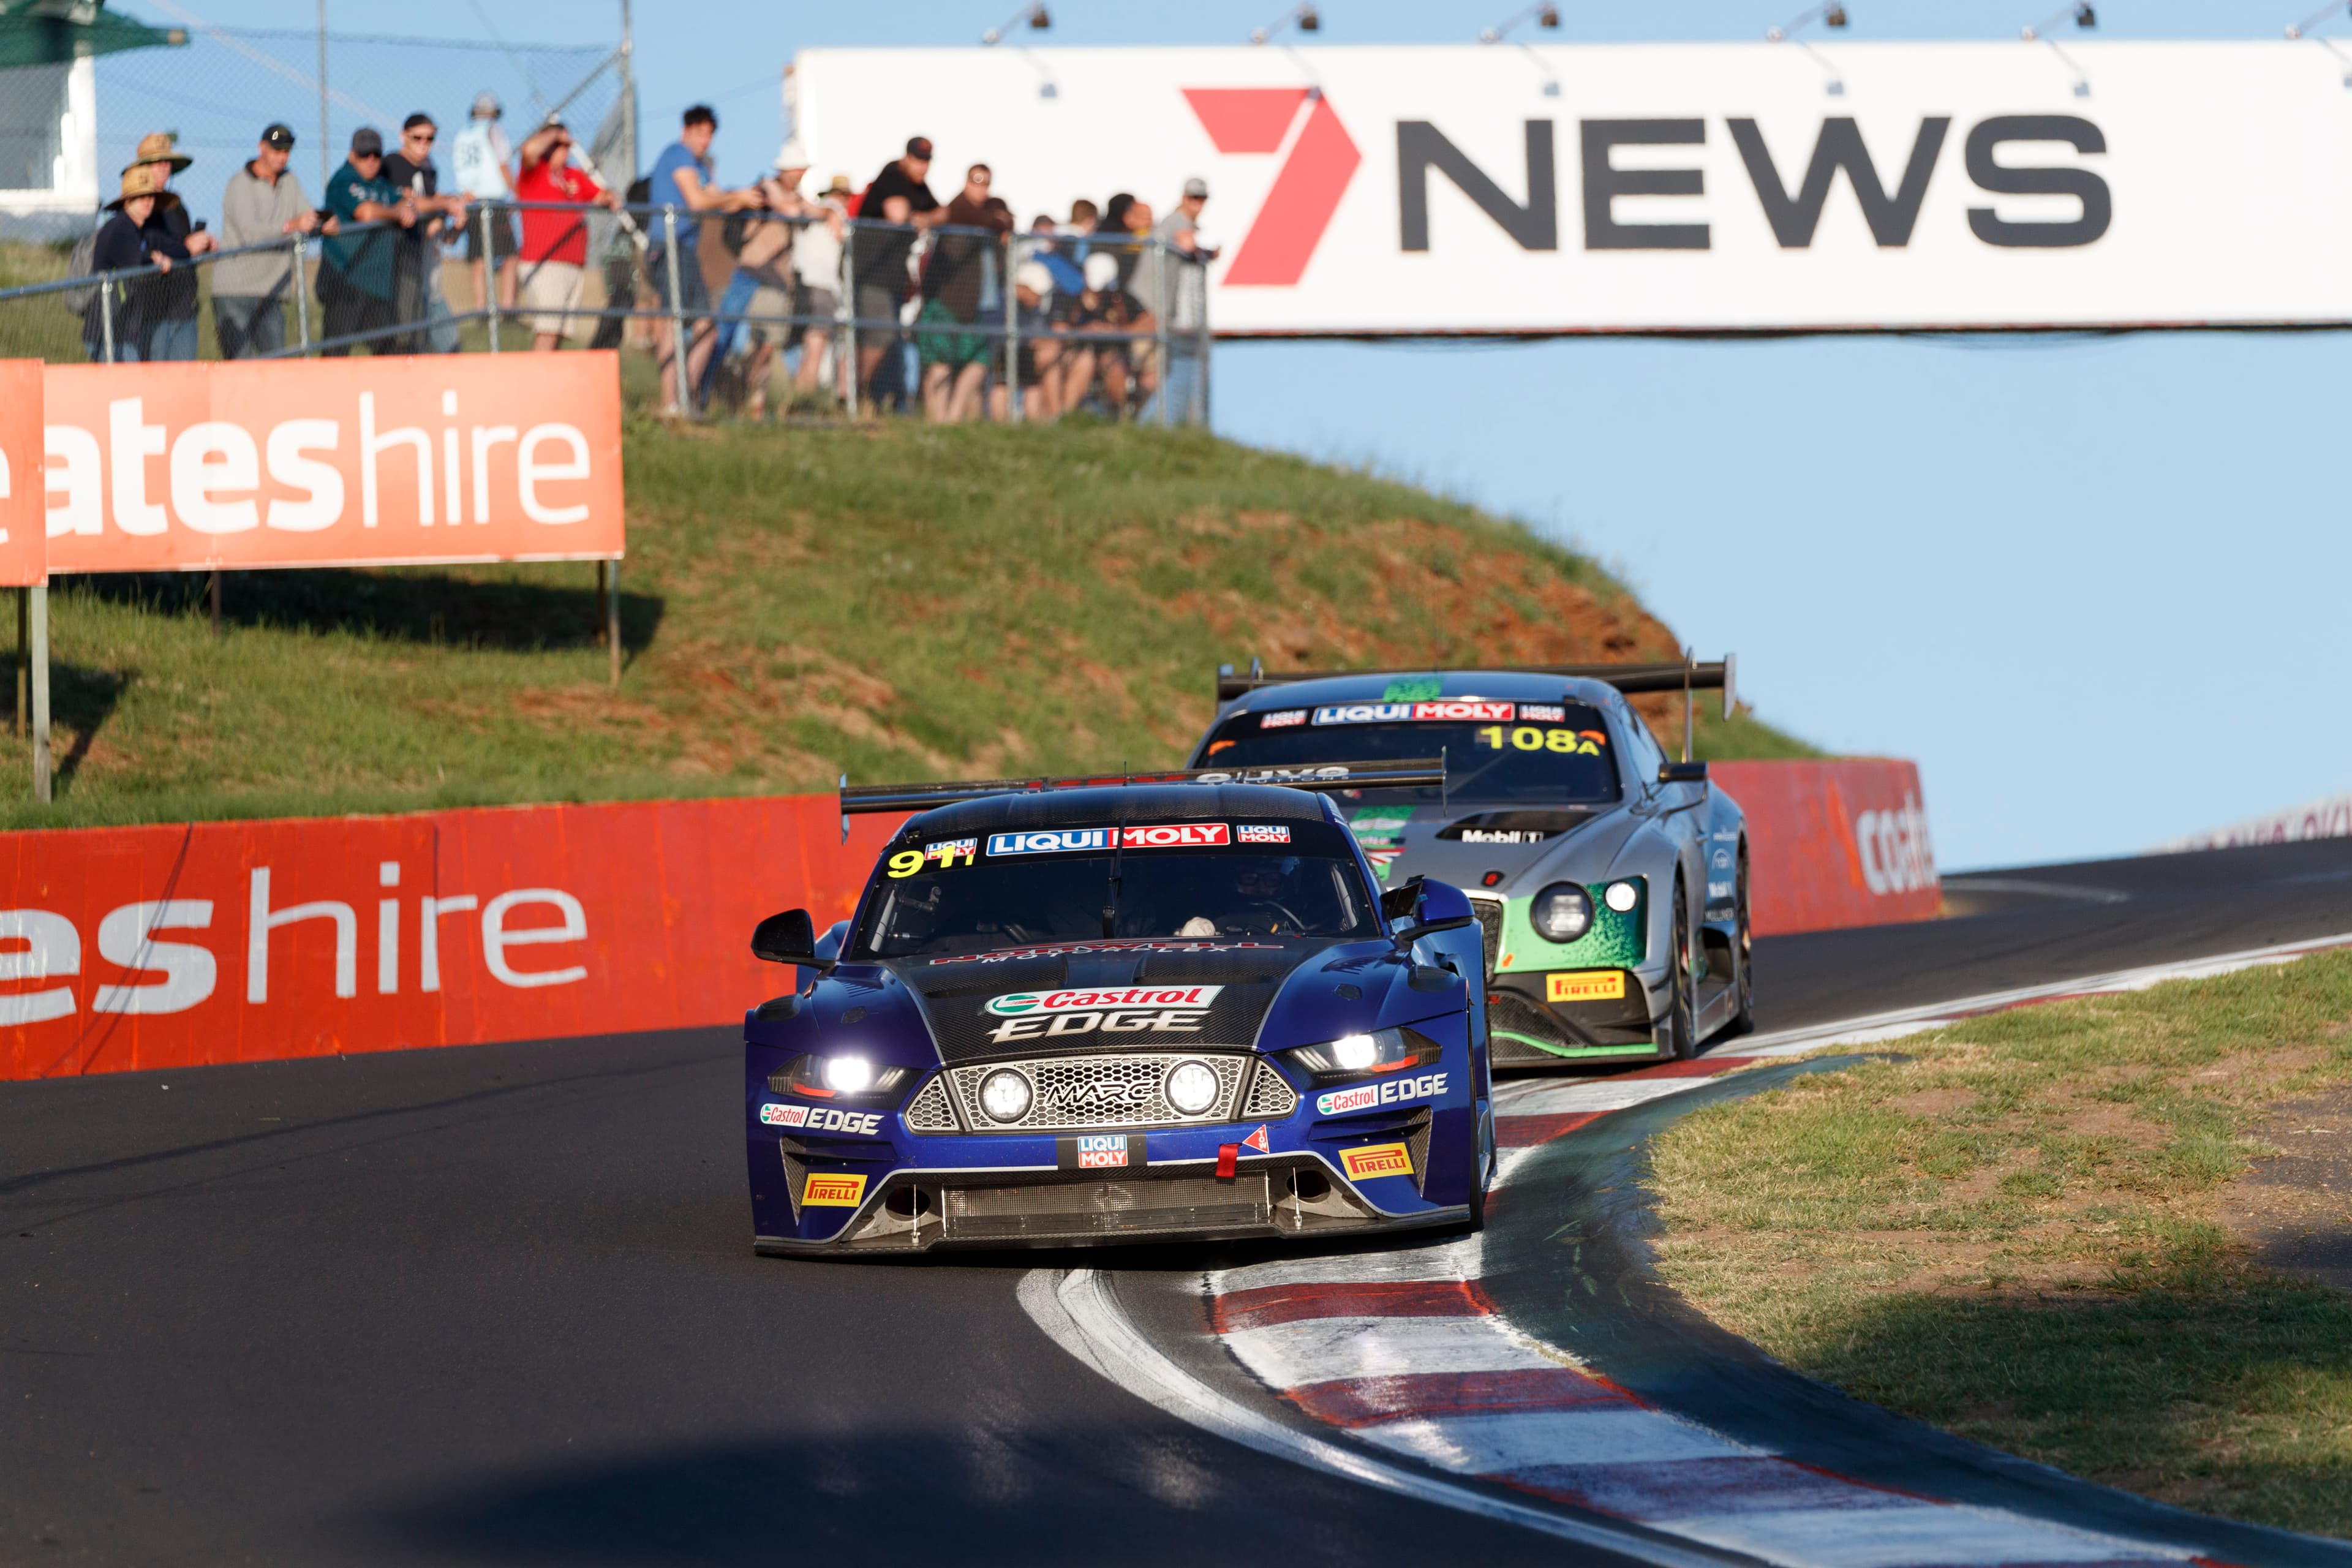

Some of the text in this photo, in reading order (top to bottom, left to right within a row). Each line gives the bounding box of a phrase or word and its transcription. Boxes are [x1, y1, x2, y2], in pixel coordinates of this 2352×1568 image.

[1395, 114, 2114, 252] NEWS
[1318, 704, 1511, 723] LIQUI MOLY
[993, 825, 1224, 853] LIQUI MOLY
[1238, 834, 1288, 842] MOLY
[1240, 826, 1286, 834] LIQUI
[1462, 829, 1521, 843] Mobil
[1555, 977, 1616, 995] PIRELLI
[1043, 988, 1204, 1009] Castrol
[986, 1010, 1214, 1044] EDGE
[1333, 1072, 1450, 1110] Castrol EDGE
[771, 1107, 885, 1136] Castrol EDGE
[1080, 1136, 1125, 1152] LIQUI
[1258, 1130, 1267, 1149] TOW
[1081, 1151, 1126, 1166] MOLY
[1347, 1149, 1406, 1174] PIRELLI
[807, 1180, 859, 1200] PIRELLI
